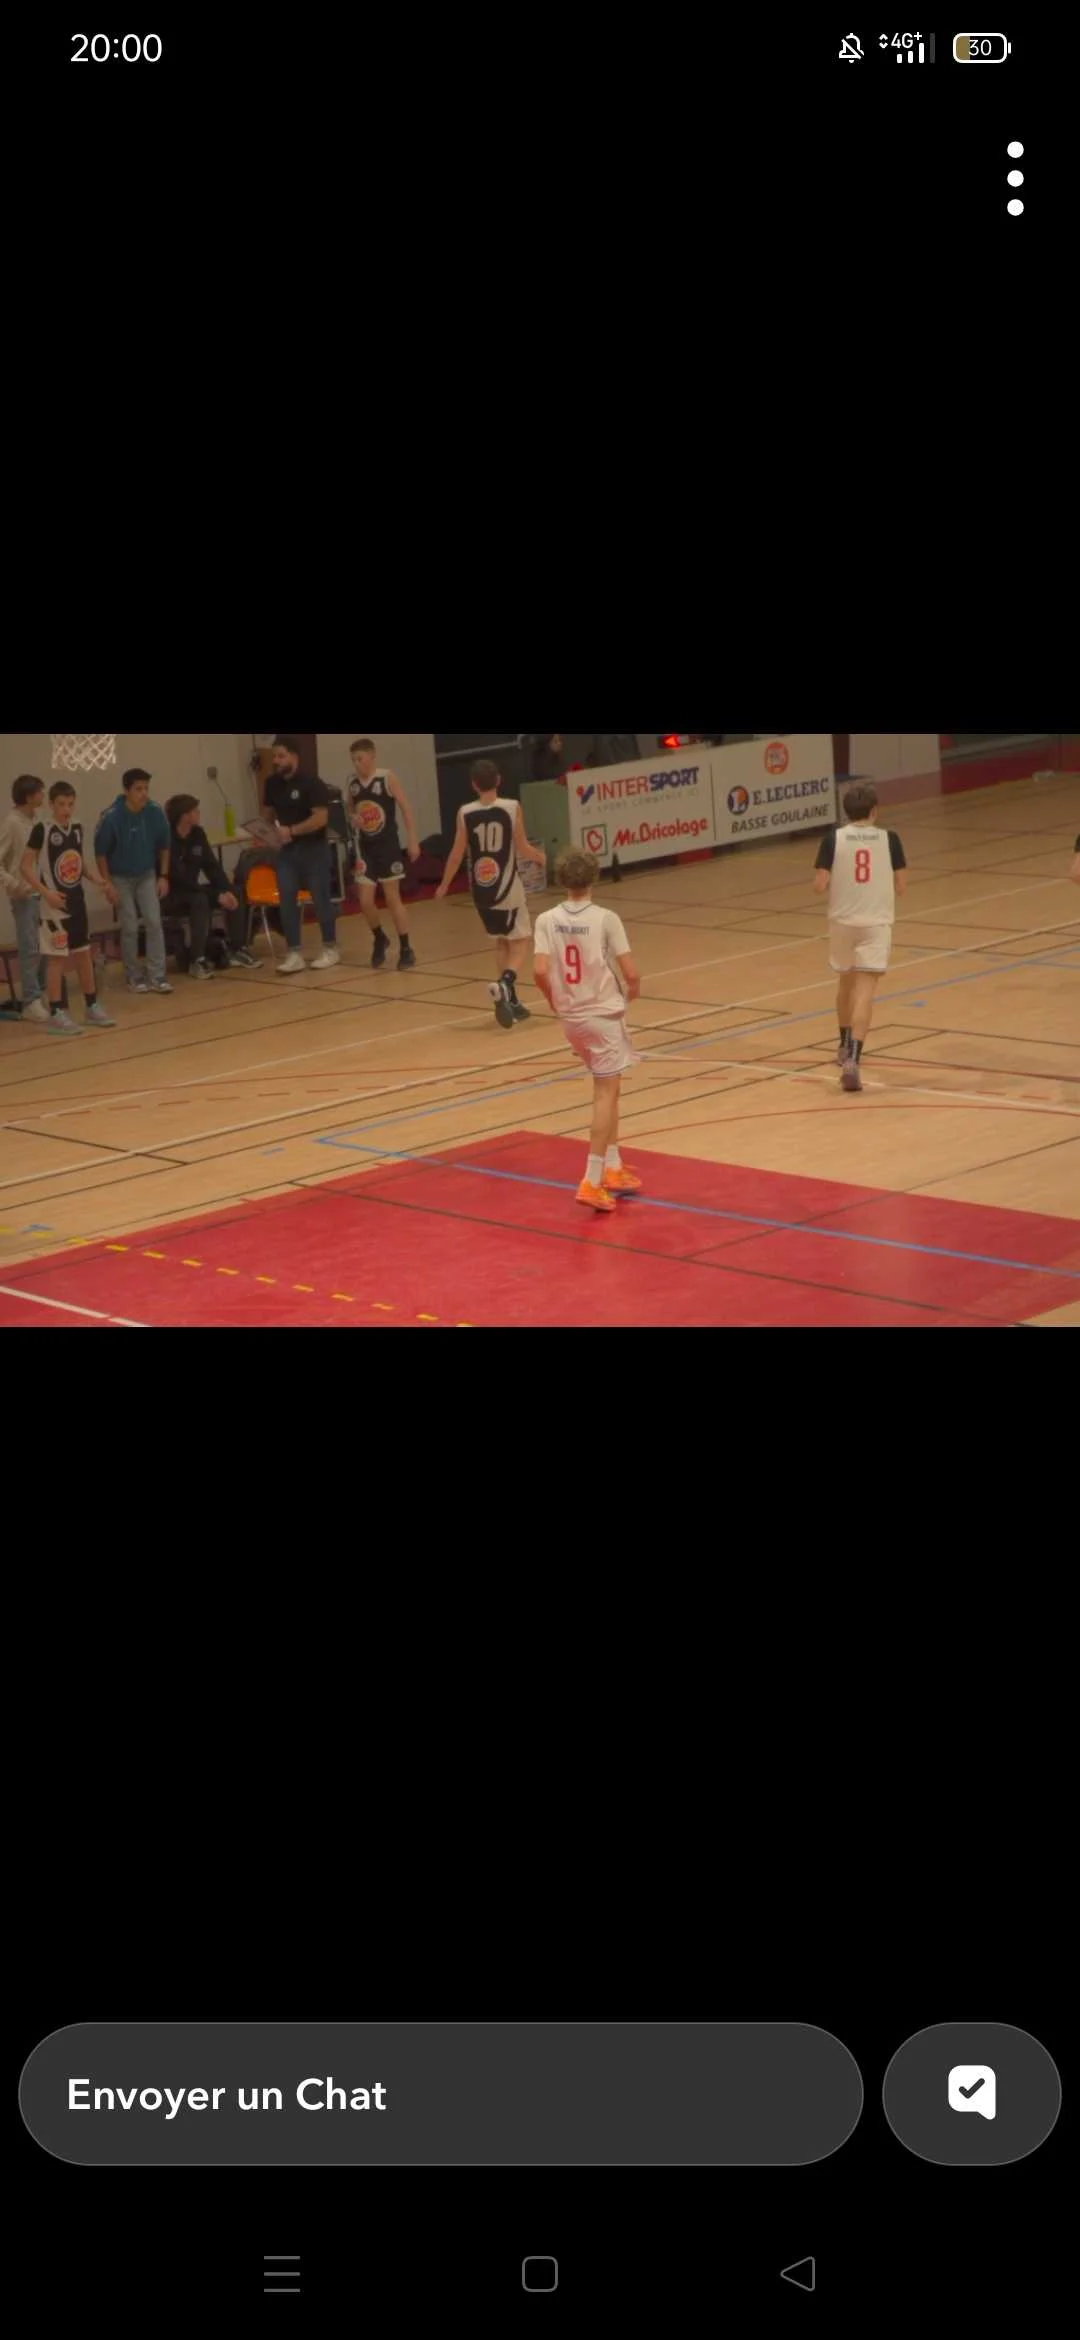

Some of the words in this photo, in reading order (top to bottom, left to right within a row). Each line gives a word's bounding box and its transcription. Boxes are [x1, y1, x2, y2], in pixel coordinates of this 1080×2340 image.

[371, 781, 383, 796] 4
[597, 766, 699, 801] INTERSPORT
[752, 777, 829, 806] E.LECLERC
[730, 816, 769, 834] BASSE
[770, 803, 831, 826] GOULAINE
[472, 821, 504, 852] 10
[855, 848, 870, 885] 8
[564, 943, 581, 985] 9
